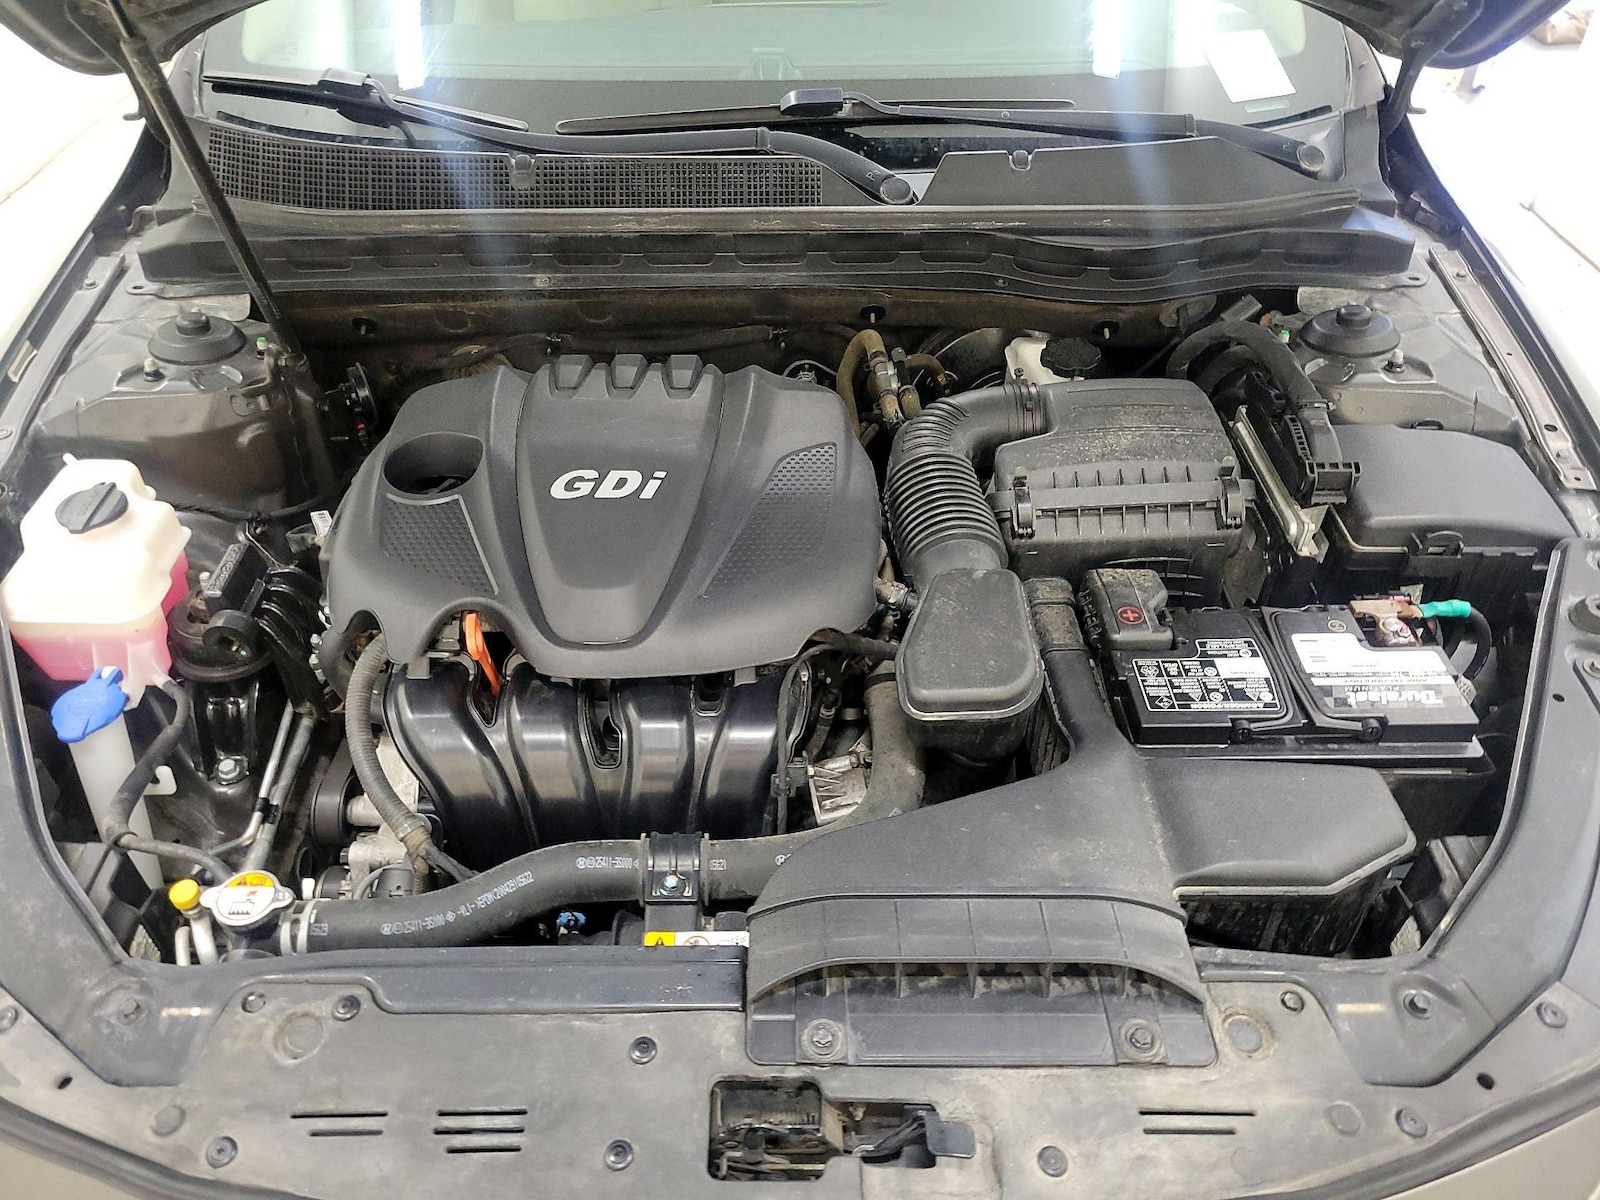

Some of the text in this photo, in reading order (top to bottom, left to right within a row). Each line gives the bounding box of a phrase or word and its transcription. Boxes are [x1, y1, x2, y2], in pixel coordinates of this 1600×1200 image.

[549, 469, 668, 500] GDi
[1344, 684, 1399, 692] PLATINUM
[1345, 689, 1443, 706] Duralast
